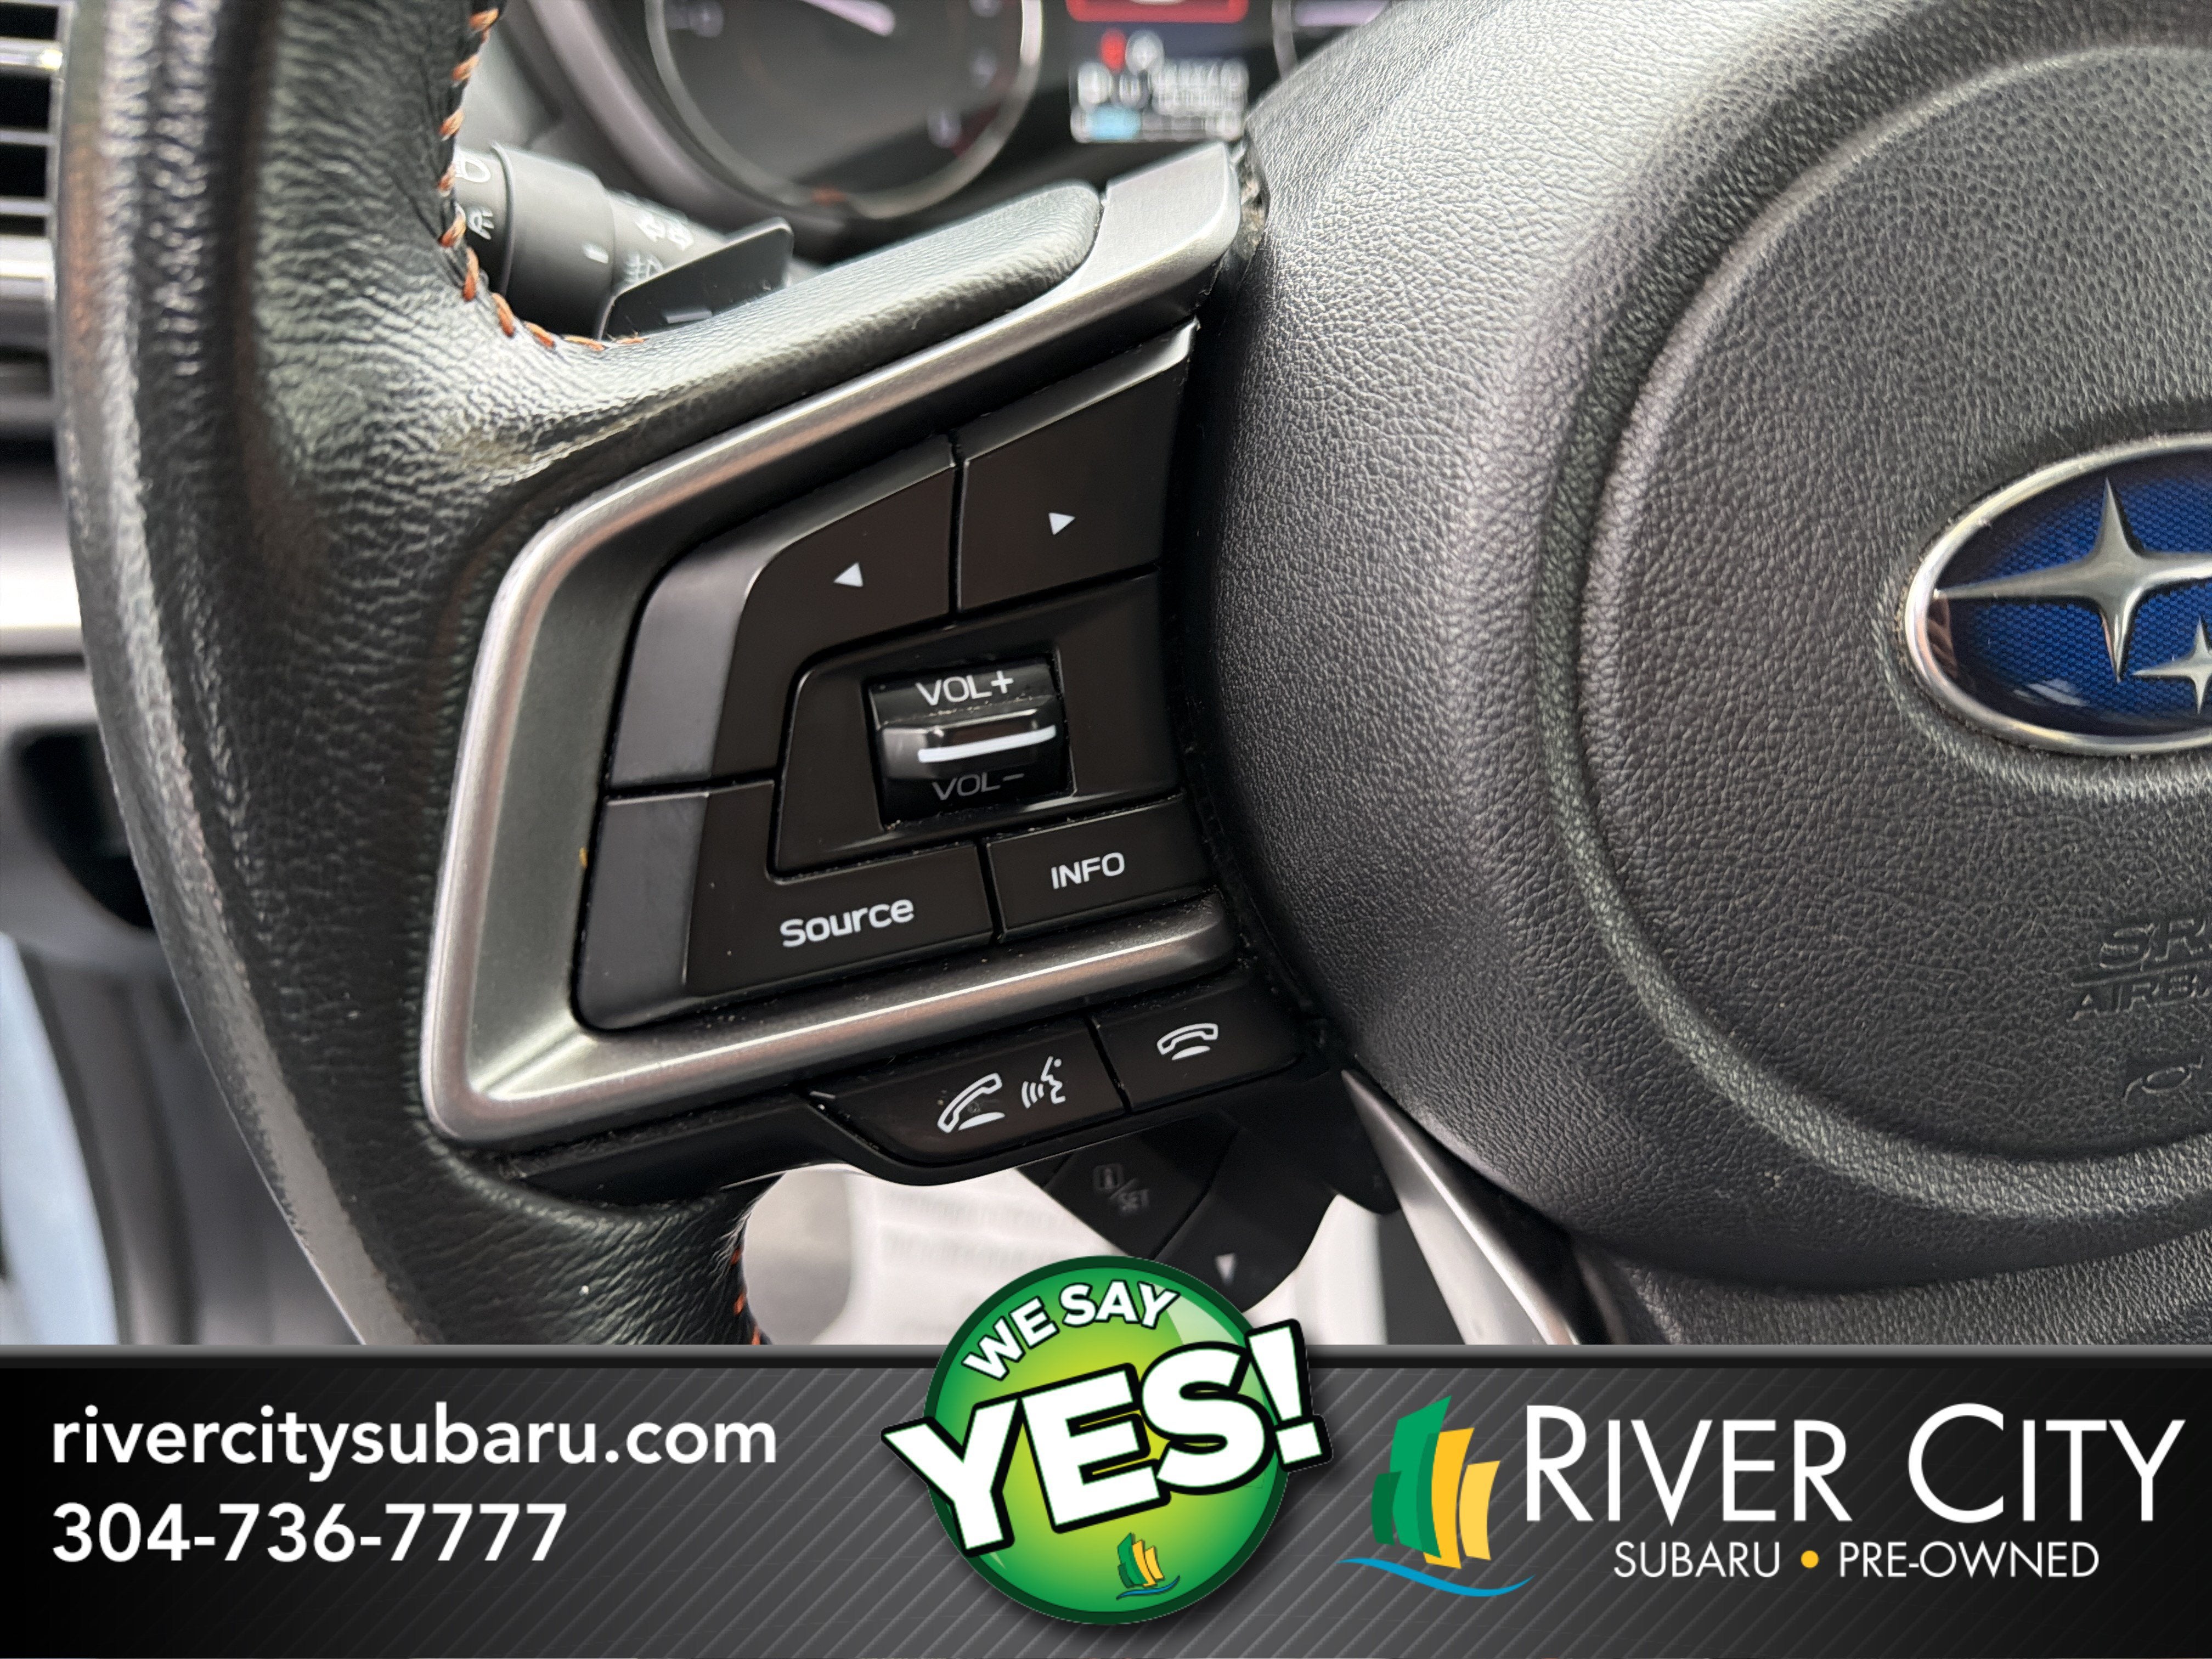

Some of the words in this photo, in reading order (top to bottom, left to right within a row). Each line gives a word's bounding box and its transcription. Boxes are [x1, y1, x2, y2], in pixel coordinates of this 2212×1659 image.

[1050, 851, 1125, 890] INFO
[779, 898, 915, 947] Source
[2099, 917, 2212, 972] SR
